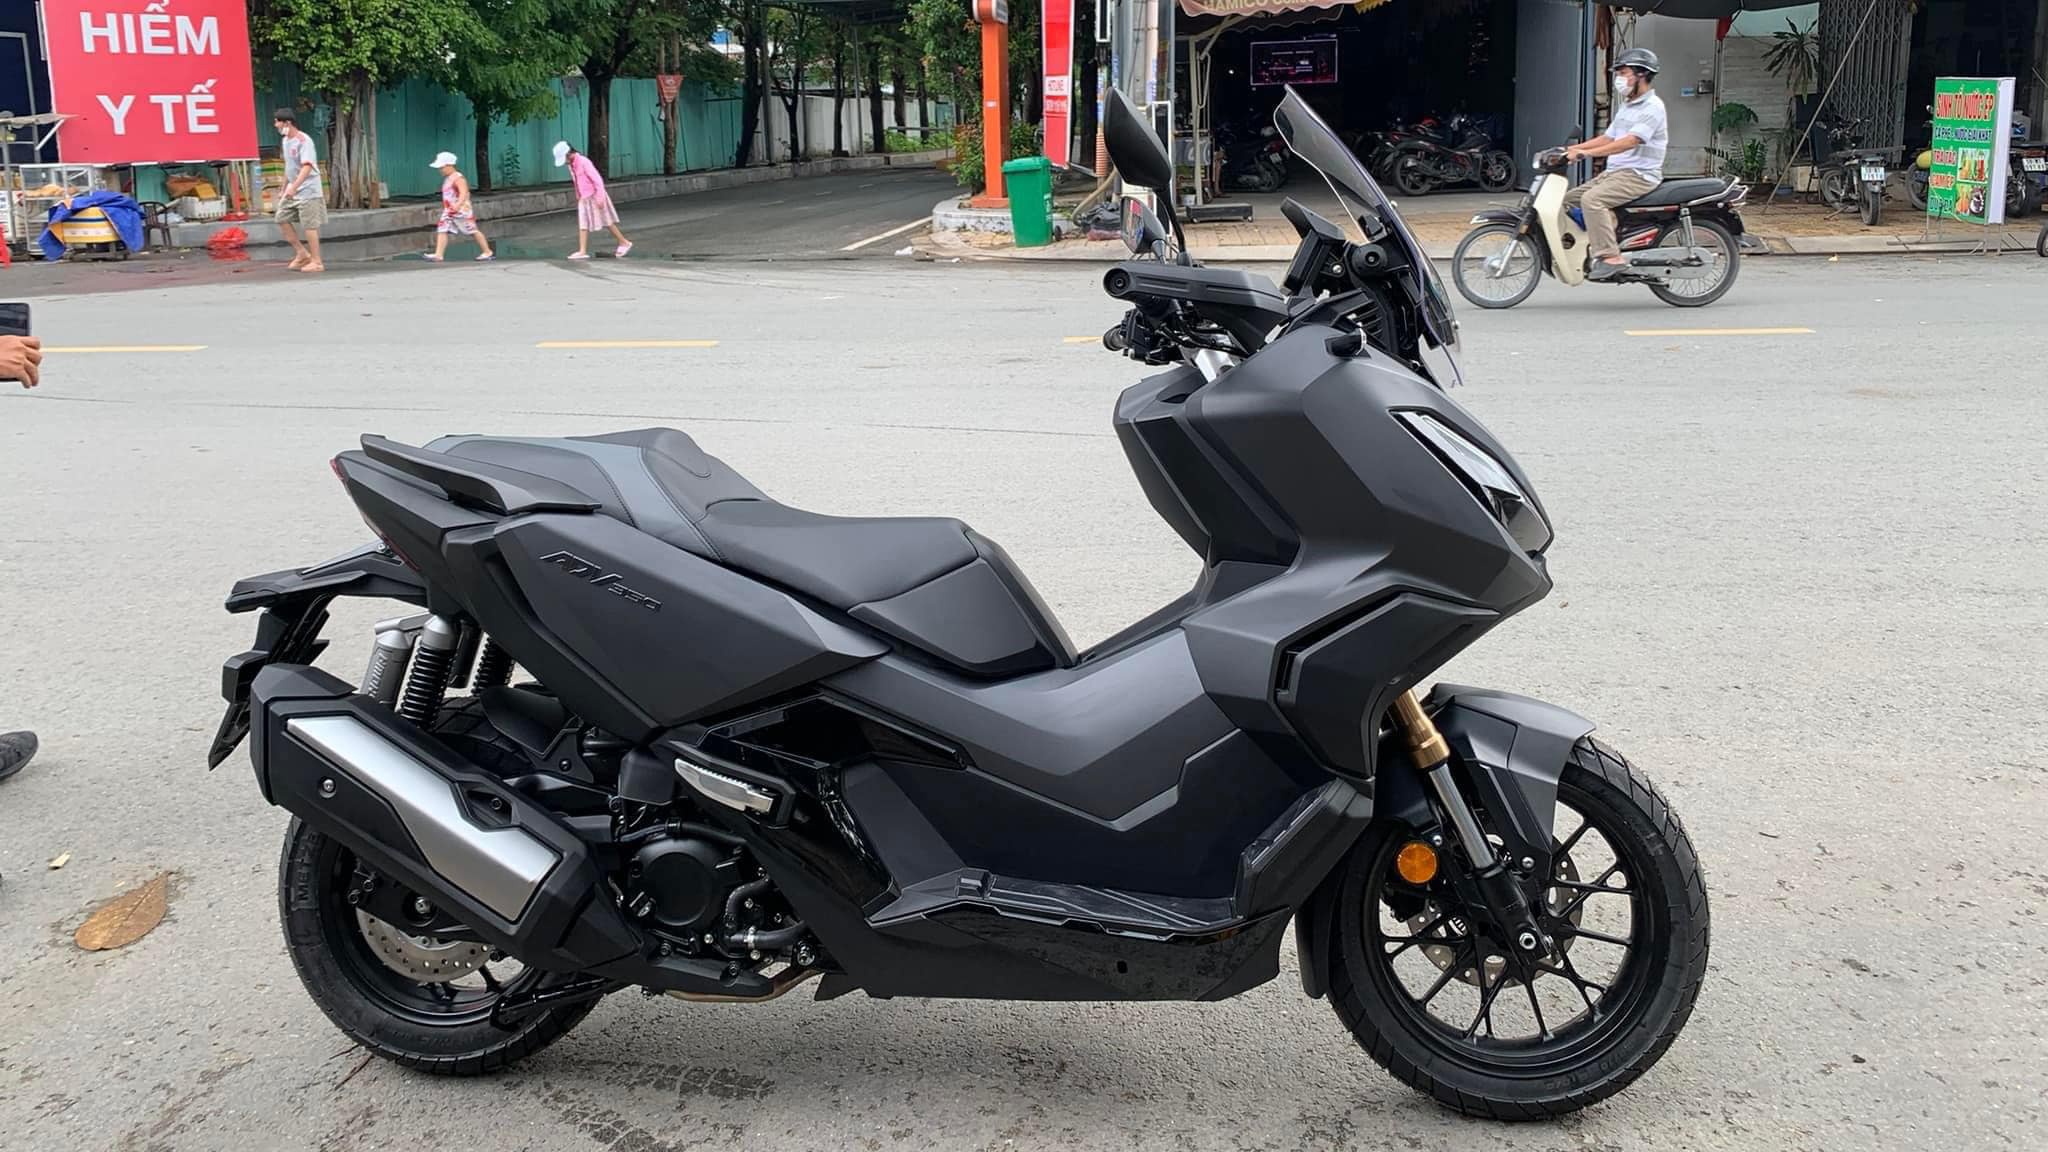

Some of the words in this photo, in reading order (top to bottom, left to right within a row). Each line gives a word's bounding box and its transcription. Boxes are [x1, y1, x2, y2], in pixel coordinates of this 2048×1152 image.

[80, 0, 221, 55] HIỂM
[96, 95, 136, 135] Y
[149, 79, 220, 134] TẾ
